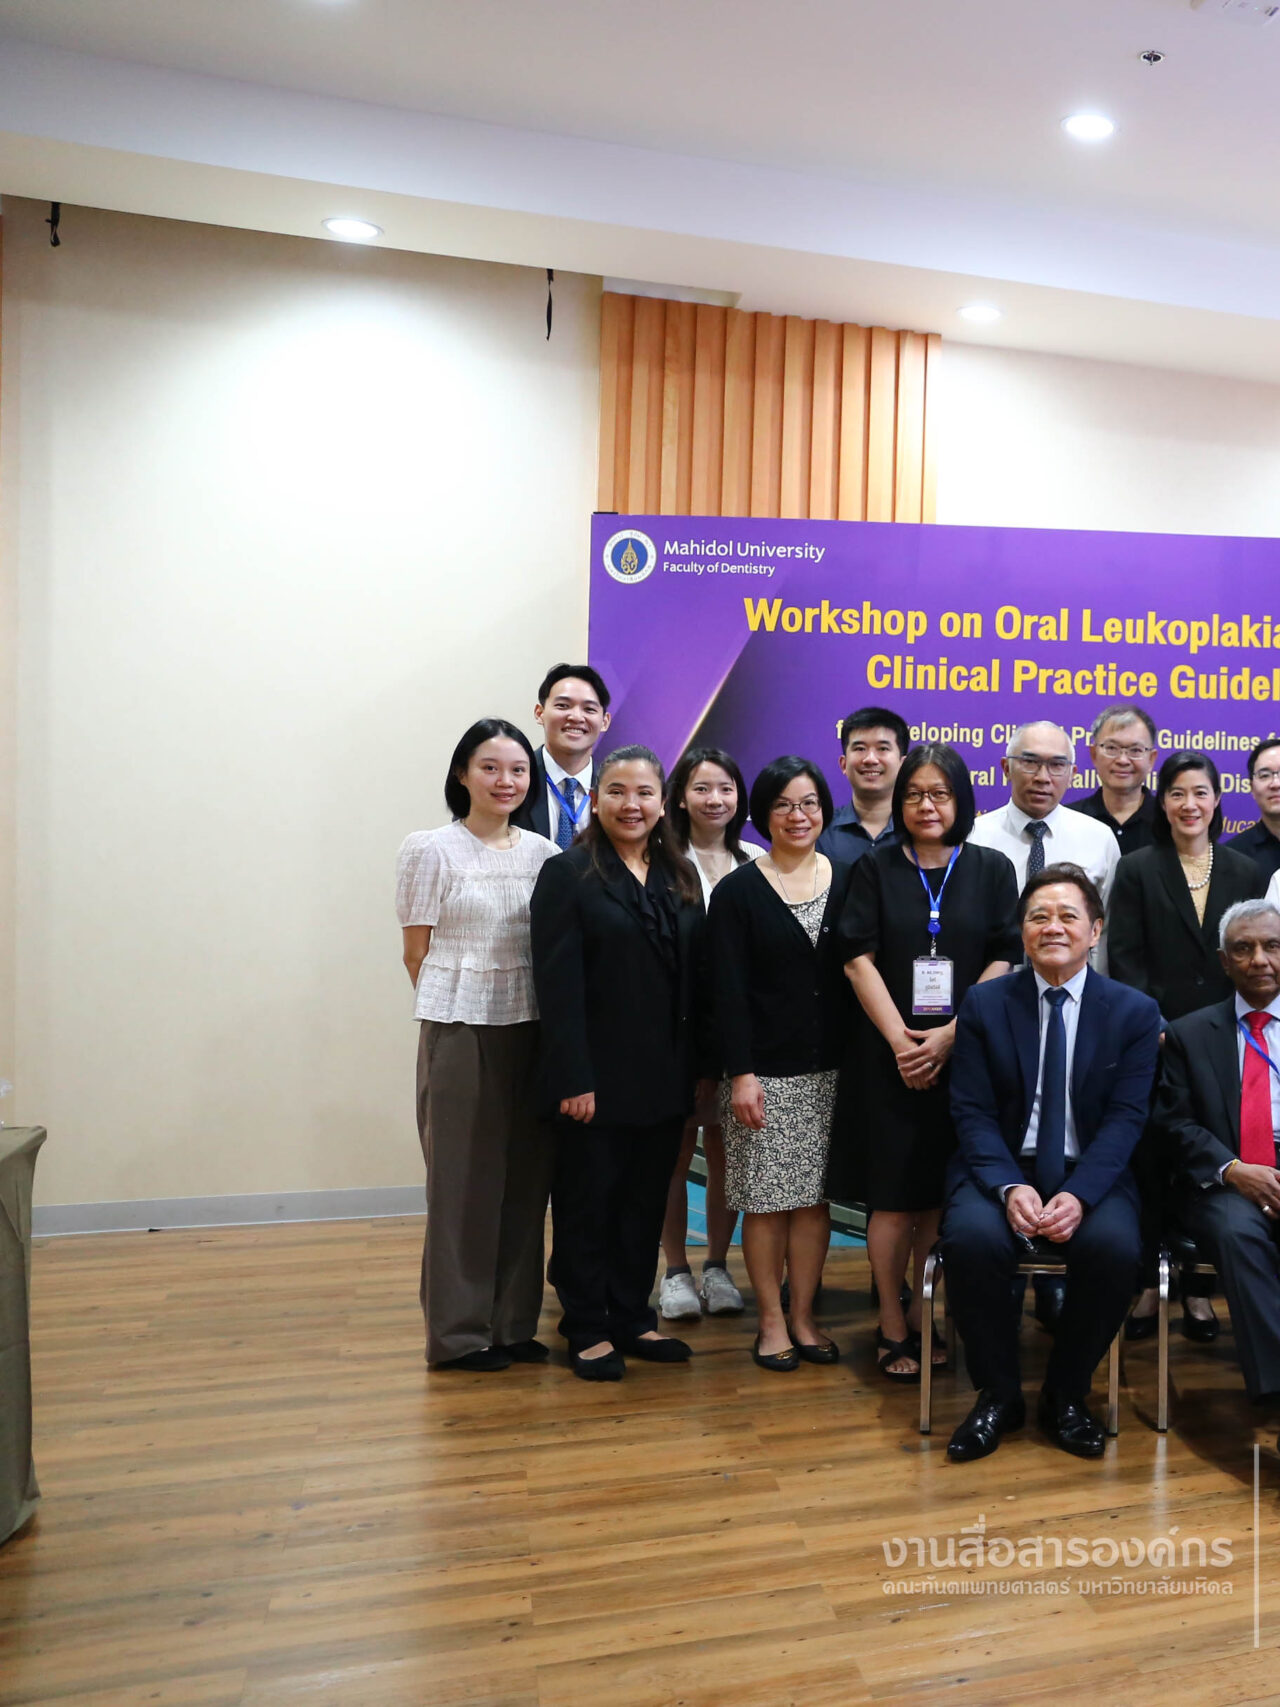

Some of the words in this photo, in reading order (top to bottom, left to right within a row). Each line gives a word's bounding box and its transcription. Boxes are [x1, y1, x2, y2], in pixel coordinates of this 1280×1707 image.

[663, 540, 733, 557] Mahidol
[737, 542, 826, 563] University
[663, 562, 704, 575] Faculty
[706, 562, 719, 573] of
[721, 563, 775, 577] Dentistry
[744, 597, 927, 644] Workshop
[939, 612, 982, 638] on
[995, 605, 1069, 641] Oral
[866, 654, 1000, 692] Clinical
[1013, 659, 1158, 698] Practice
[1157, 729, 1261, 752] Guidelines
